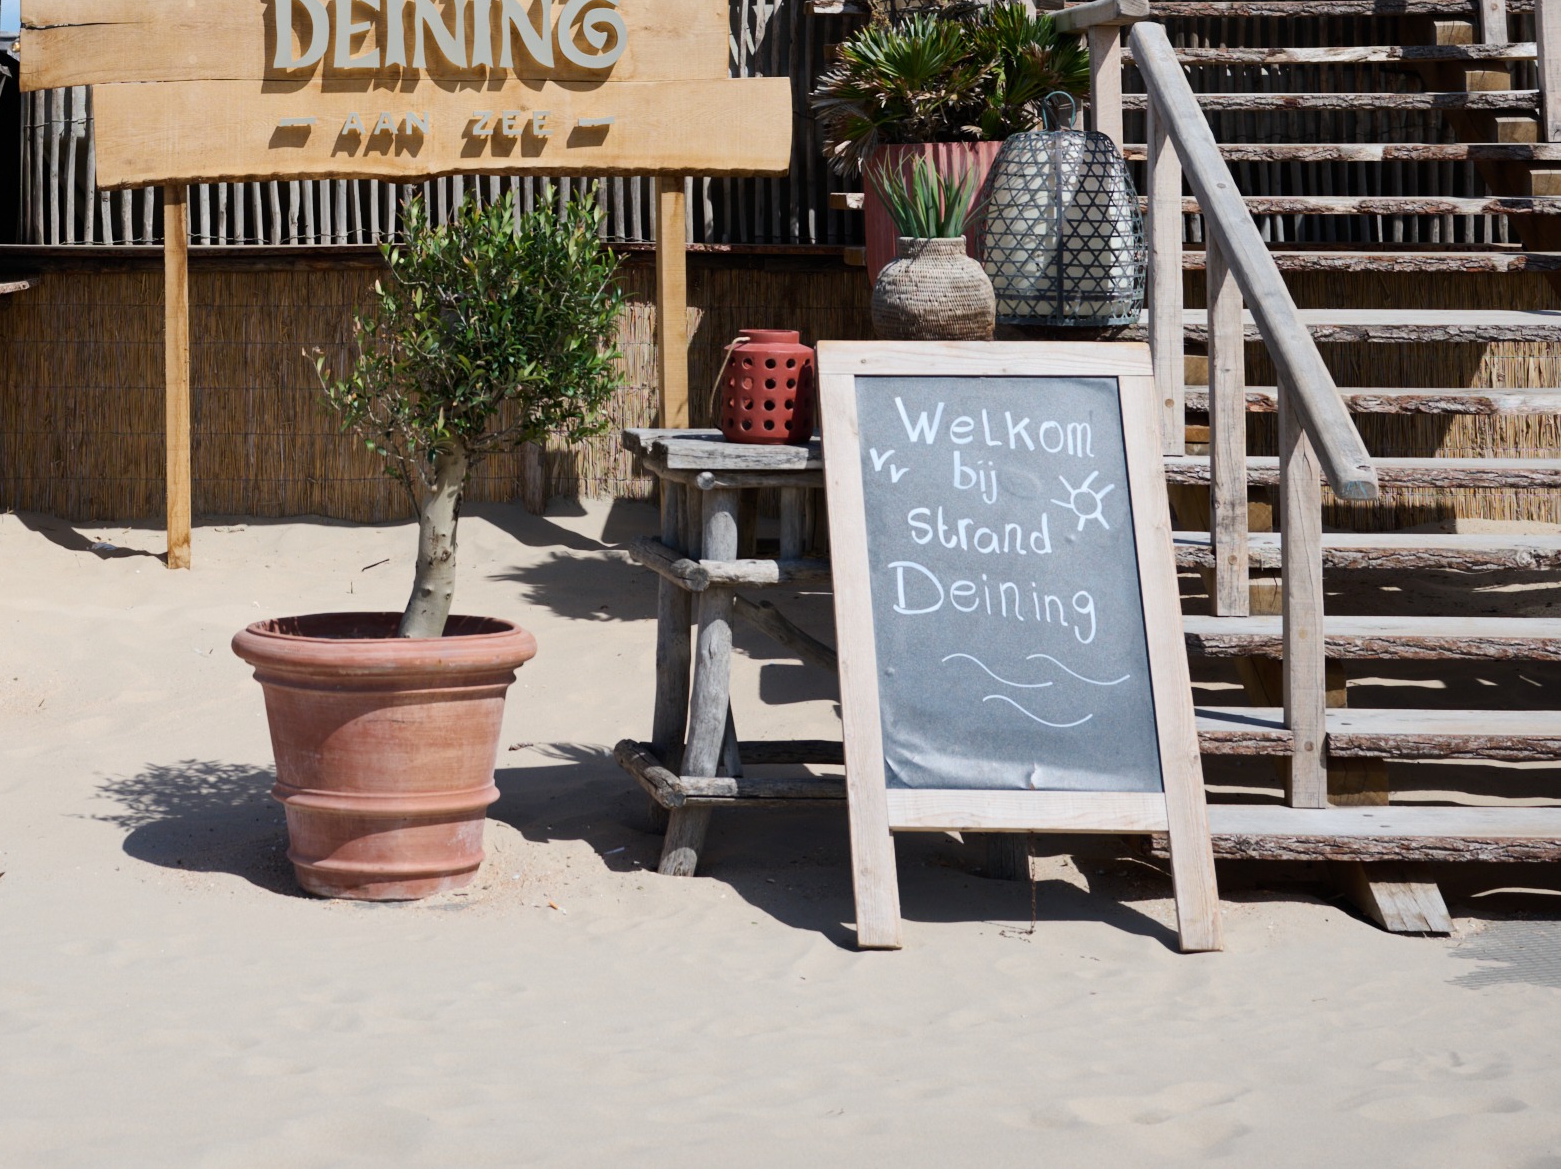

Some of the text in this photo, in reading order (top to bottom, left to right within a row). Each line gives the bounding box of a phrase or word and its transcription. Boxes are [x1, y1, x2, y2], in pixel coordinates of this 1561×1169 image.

[341, 110, 553, 136] AAN ZEE
[894, 396, 1095, 458] Welkom
[953, 450, 998, 504] bij
[888, 560, 1097, 644] Deining
